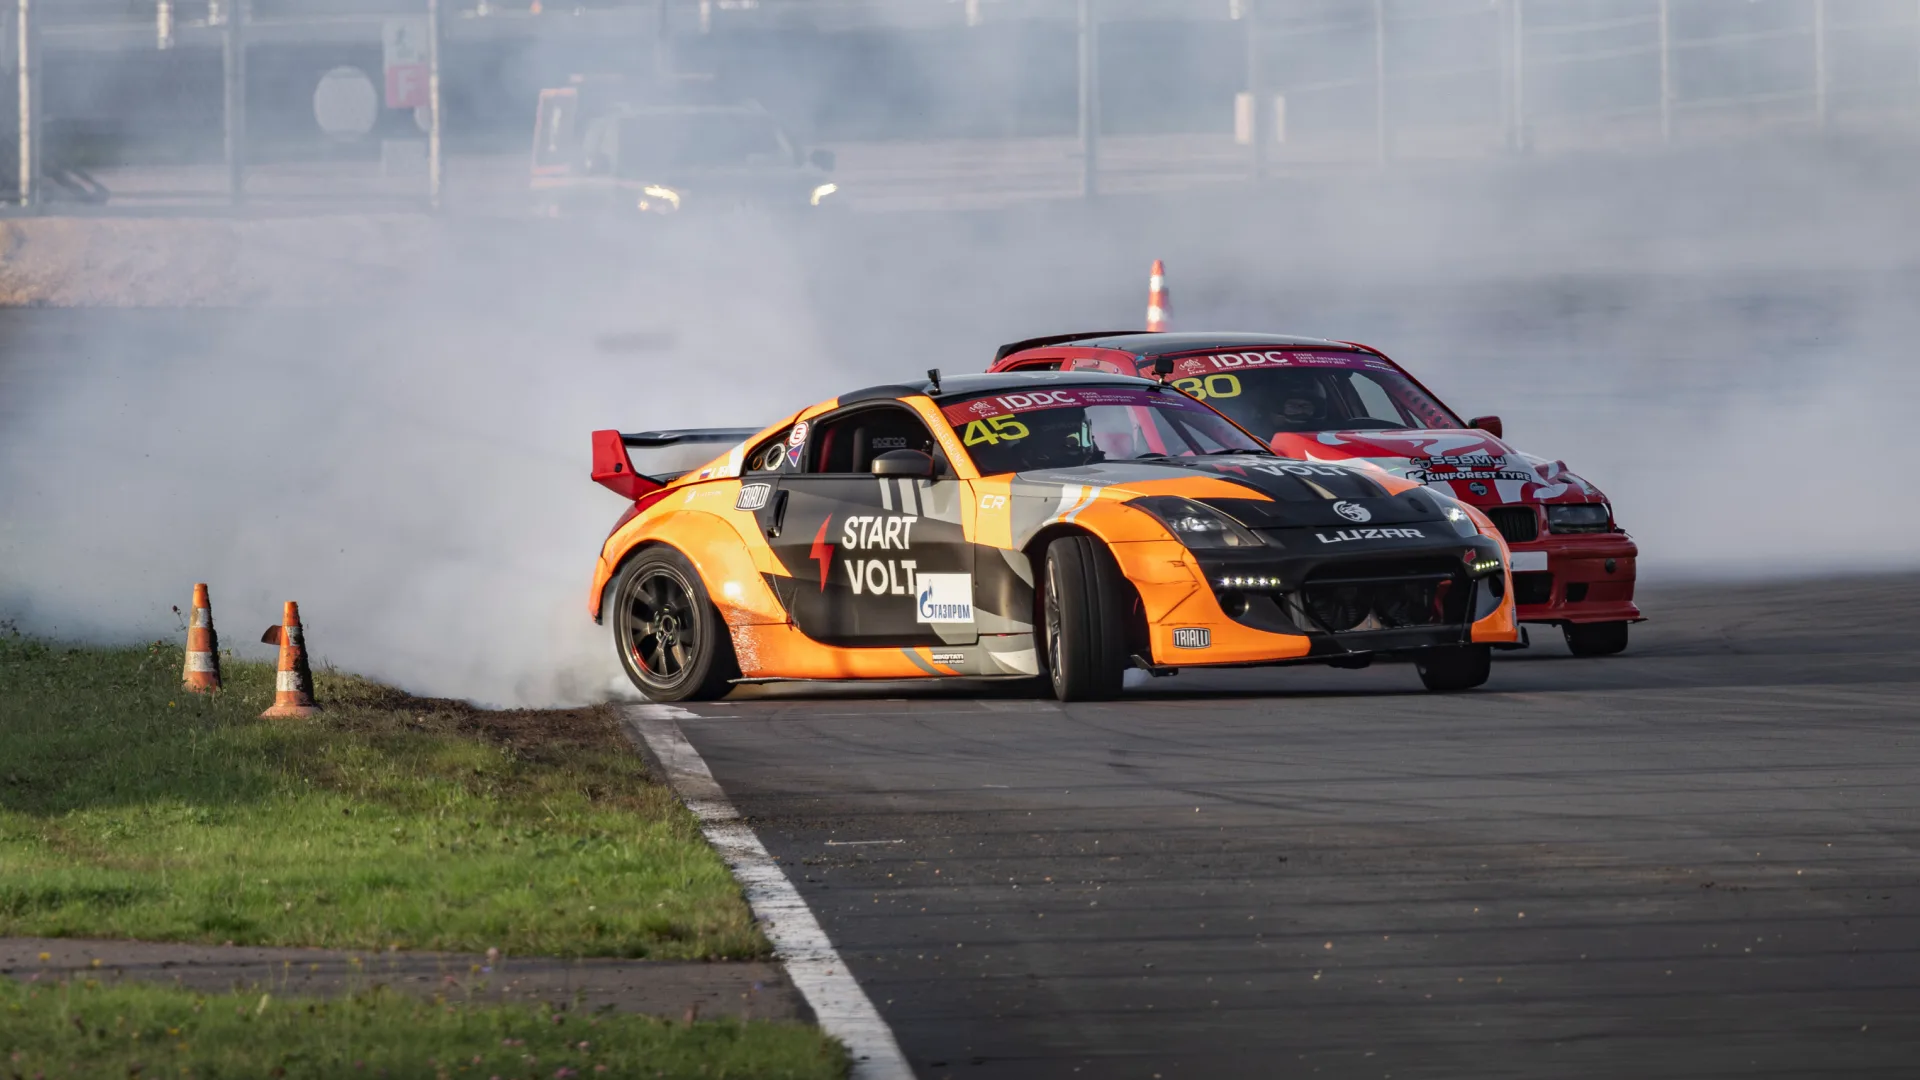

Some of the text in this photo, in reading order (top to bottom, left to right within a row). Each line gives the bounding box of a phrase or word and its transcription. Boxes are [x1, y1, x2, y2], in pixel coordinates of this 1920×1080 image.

[396, 69, 419, 102] F
[1208, 351, 1288, 368] IDDC
[996, 391, 1076, 409] IDDC
[794, 427, 803, 440] E
[963, 413, 1030, 447] 45
[1431, 455, 1507, 466] SSBMW
[1252, 465, 1348, 476] VOLT
[1426, 472, 1497, 481] KINFOREST
[1500, 472, 1530, 481] TYRE
[980, 494, 1006, 509] CR
[842, 516, 918, 550] START
[1315, 528, 1425, 544] LUZAR
[844, 560, 917, 595] VOLT
[934, 604, 970, 619] ГАЗПРОМ
[1174, 630, 1209, 647] TRIALLI
